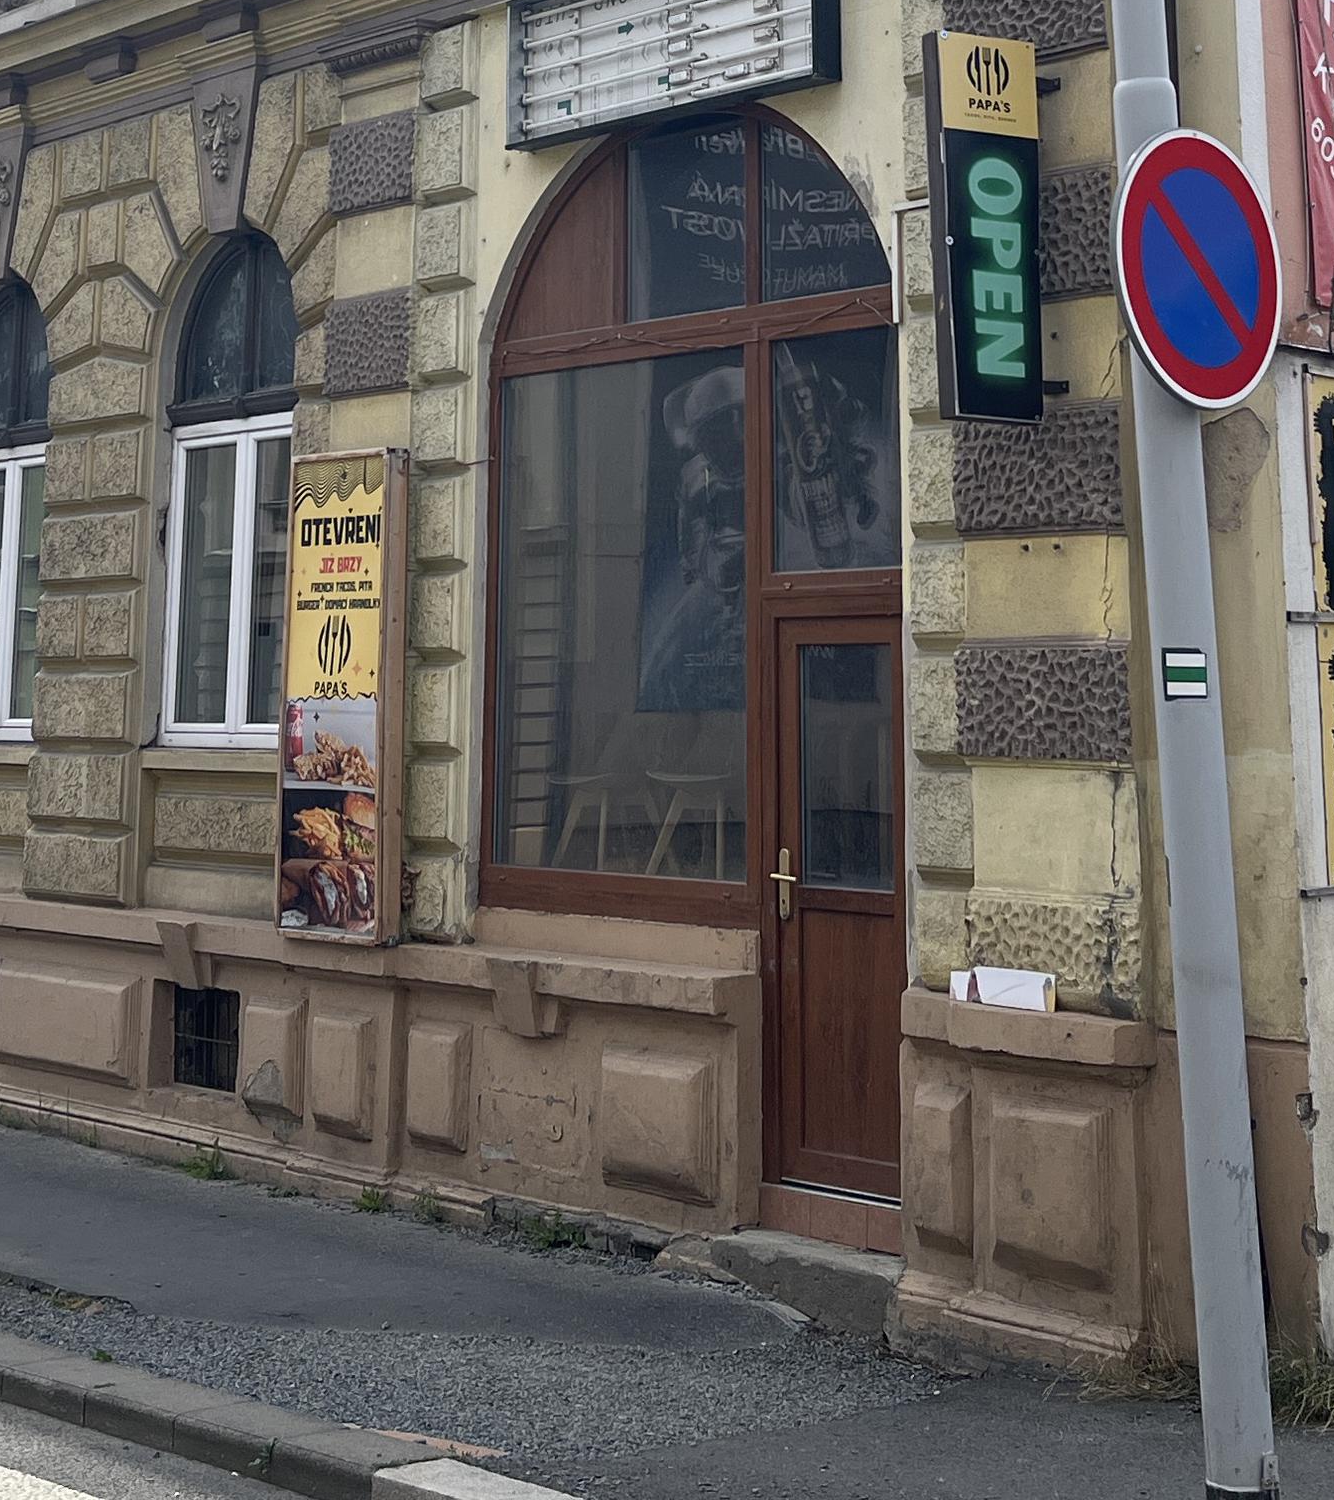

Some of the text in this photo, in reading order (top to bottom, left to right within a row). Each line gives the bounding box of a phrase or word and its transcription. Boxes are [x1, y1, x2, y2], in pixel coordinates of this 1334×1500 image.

[1313, 52, 1334, 93] K
[968, 97, 1011, 114] PAPA'S
[967, 155, 1027, 381] OPEN
[300, 506, 382, 548] OTEVŘENÍ
